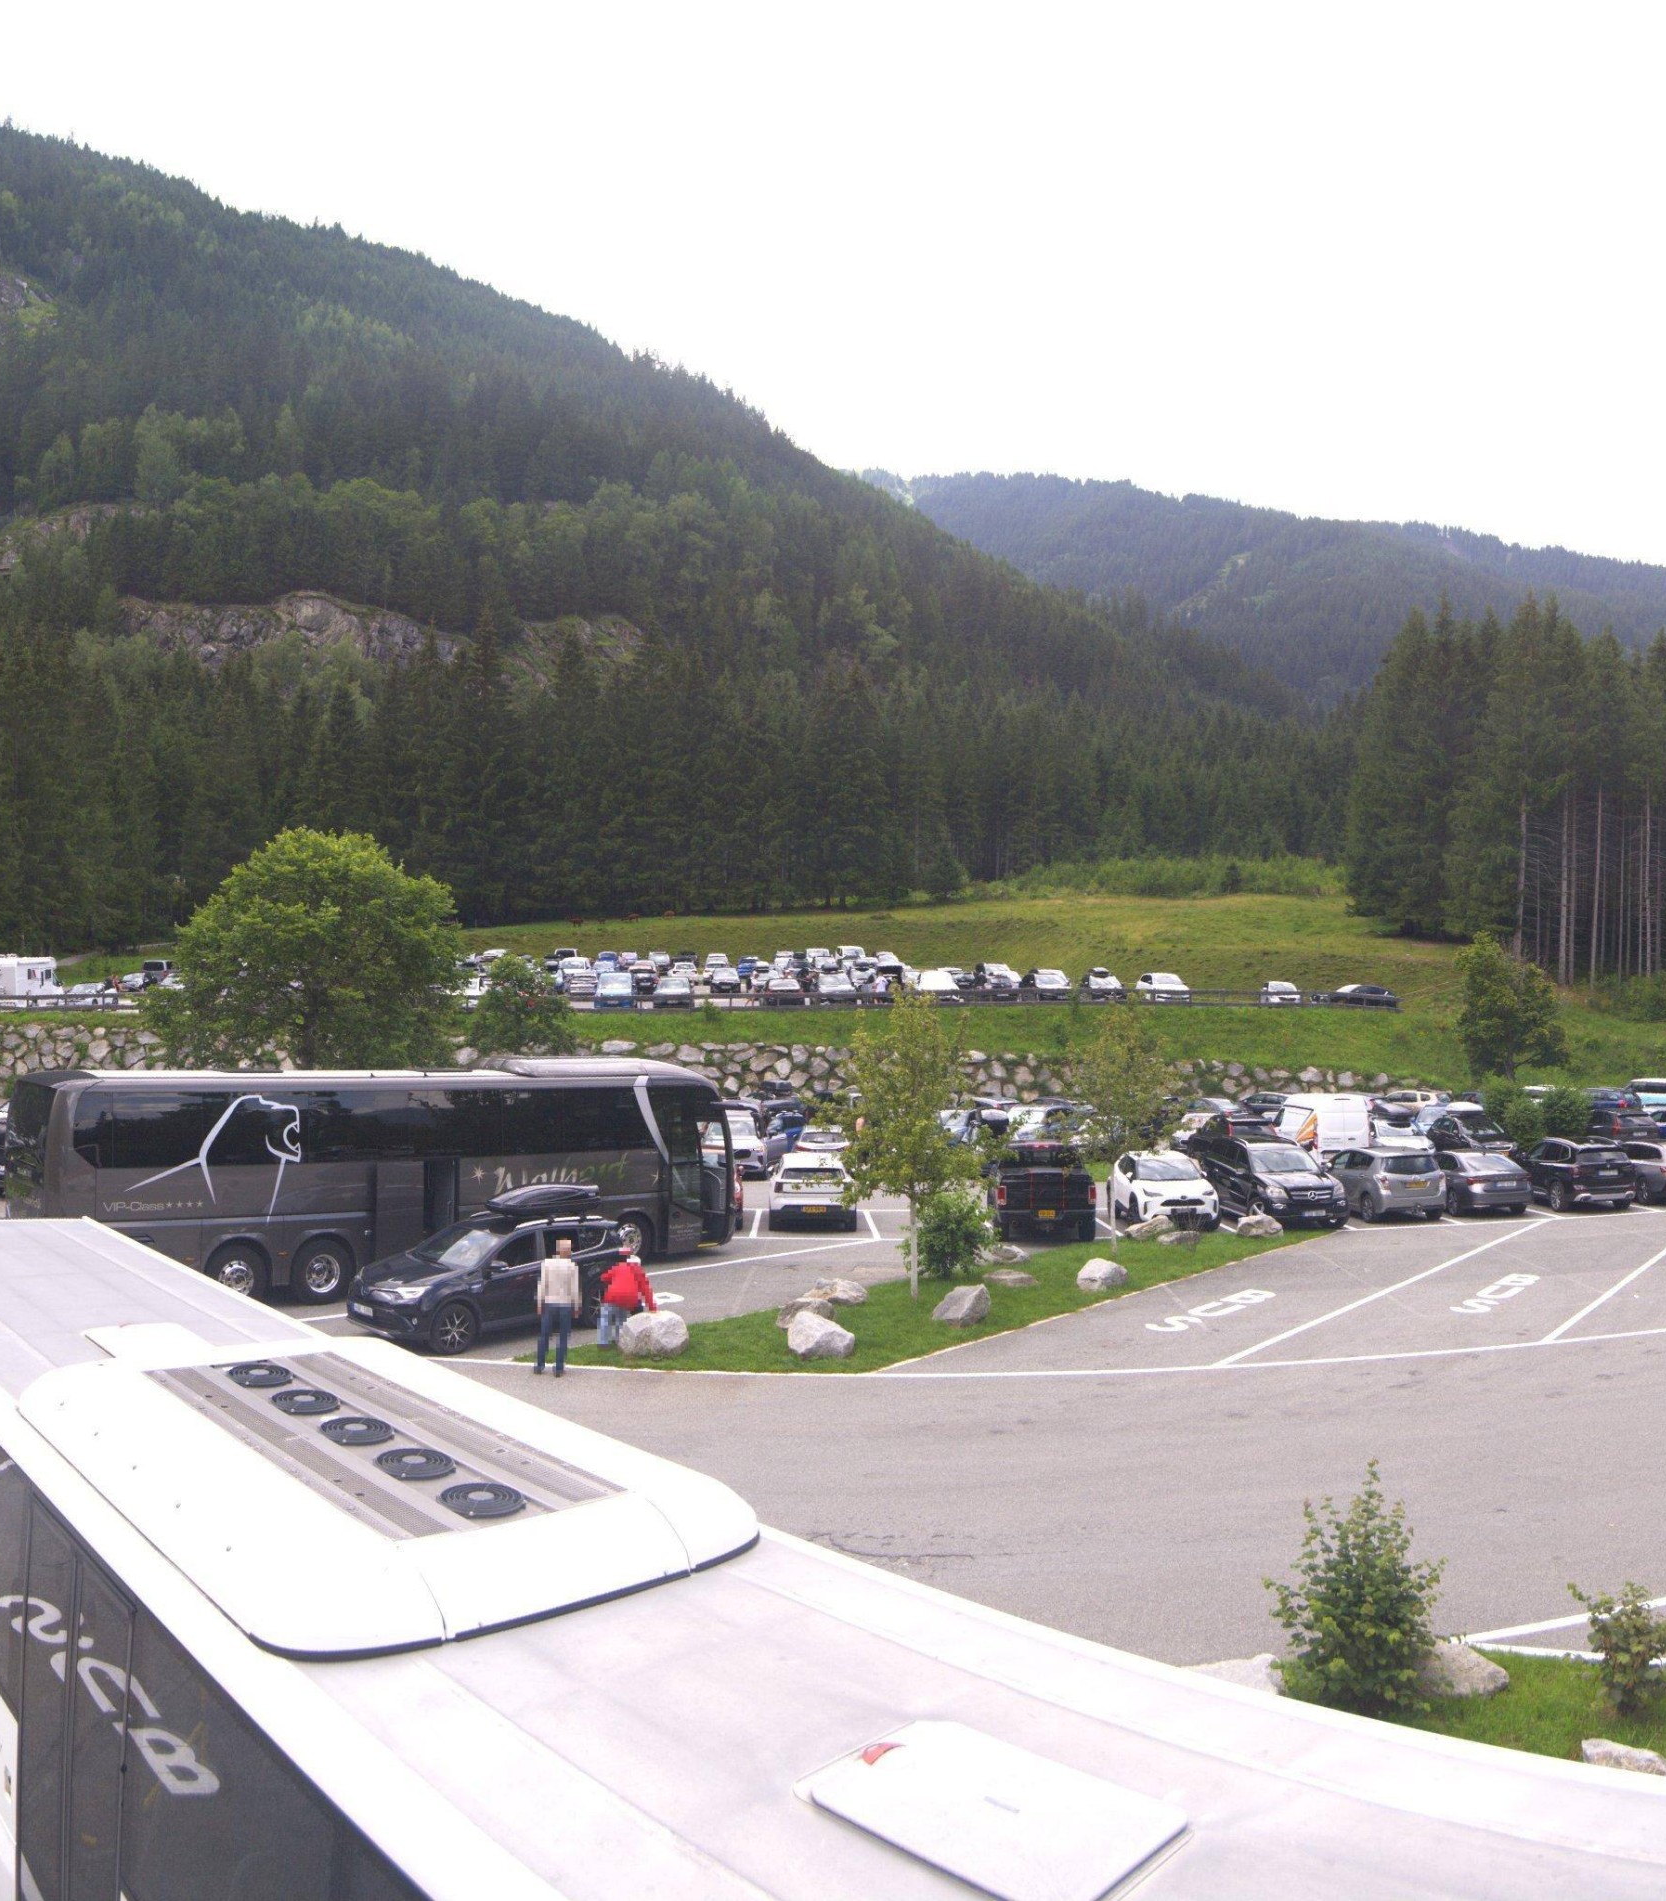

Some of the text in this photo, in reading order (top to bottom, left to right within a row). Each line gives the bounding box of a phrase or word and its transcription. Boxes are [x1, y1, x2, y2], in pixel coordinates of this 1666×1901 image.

[102, 1201, 165, 1213] VIP-Class
[1145, 1289, 1277, 1332] BUS
[1450, 1273, 1541, 1314] BUS
